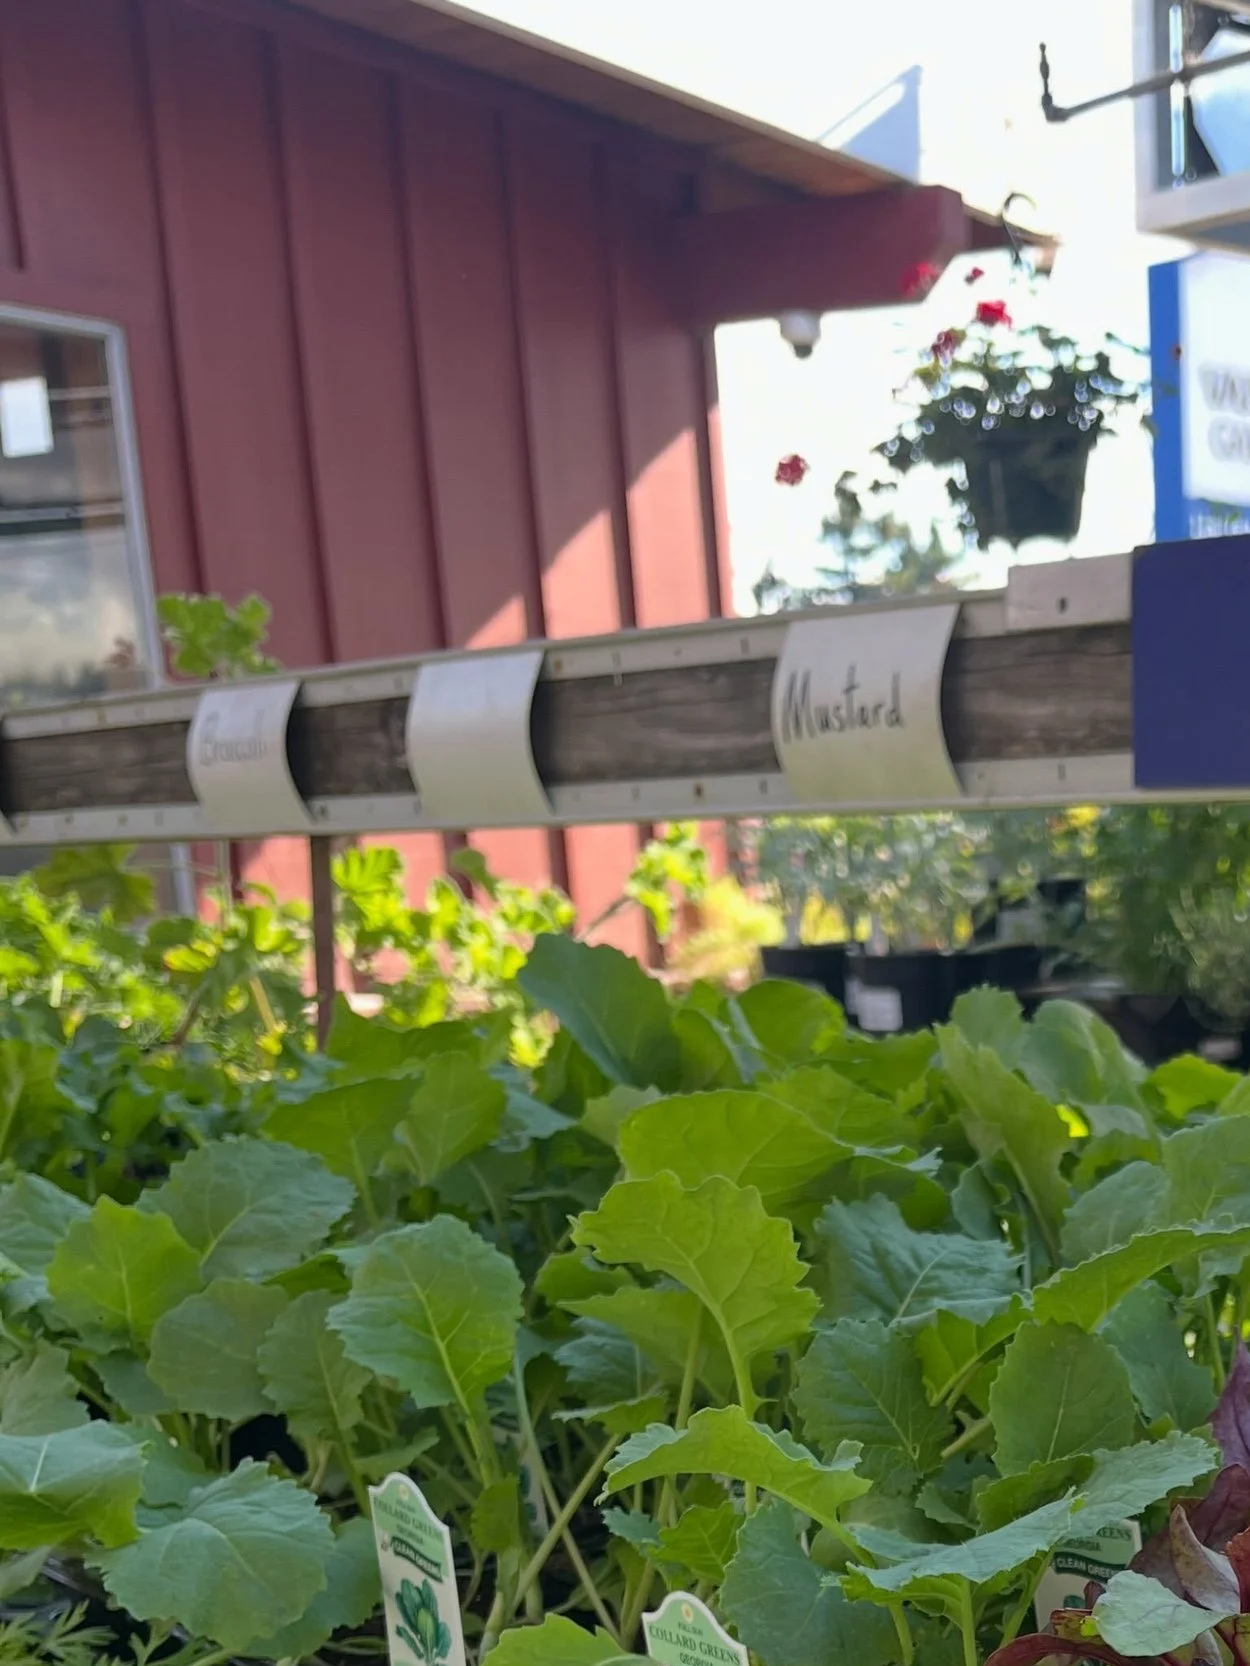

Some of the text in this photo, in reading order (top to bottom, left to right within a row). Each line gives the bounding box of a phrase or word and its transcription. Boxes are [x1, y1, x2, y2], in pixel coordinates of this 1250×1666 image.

[782, 661, 906, 744] Mustard
[1057, 1558, 1086, 1571] CLEAN
[649, 1625, 740, 1666] COLLARD GREENS
